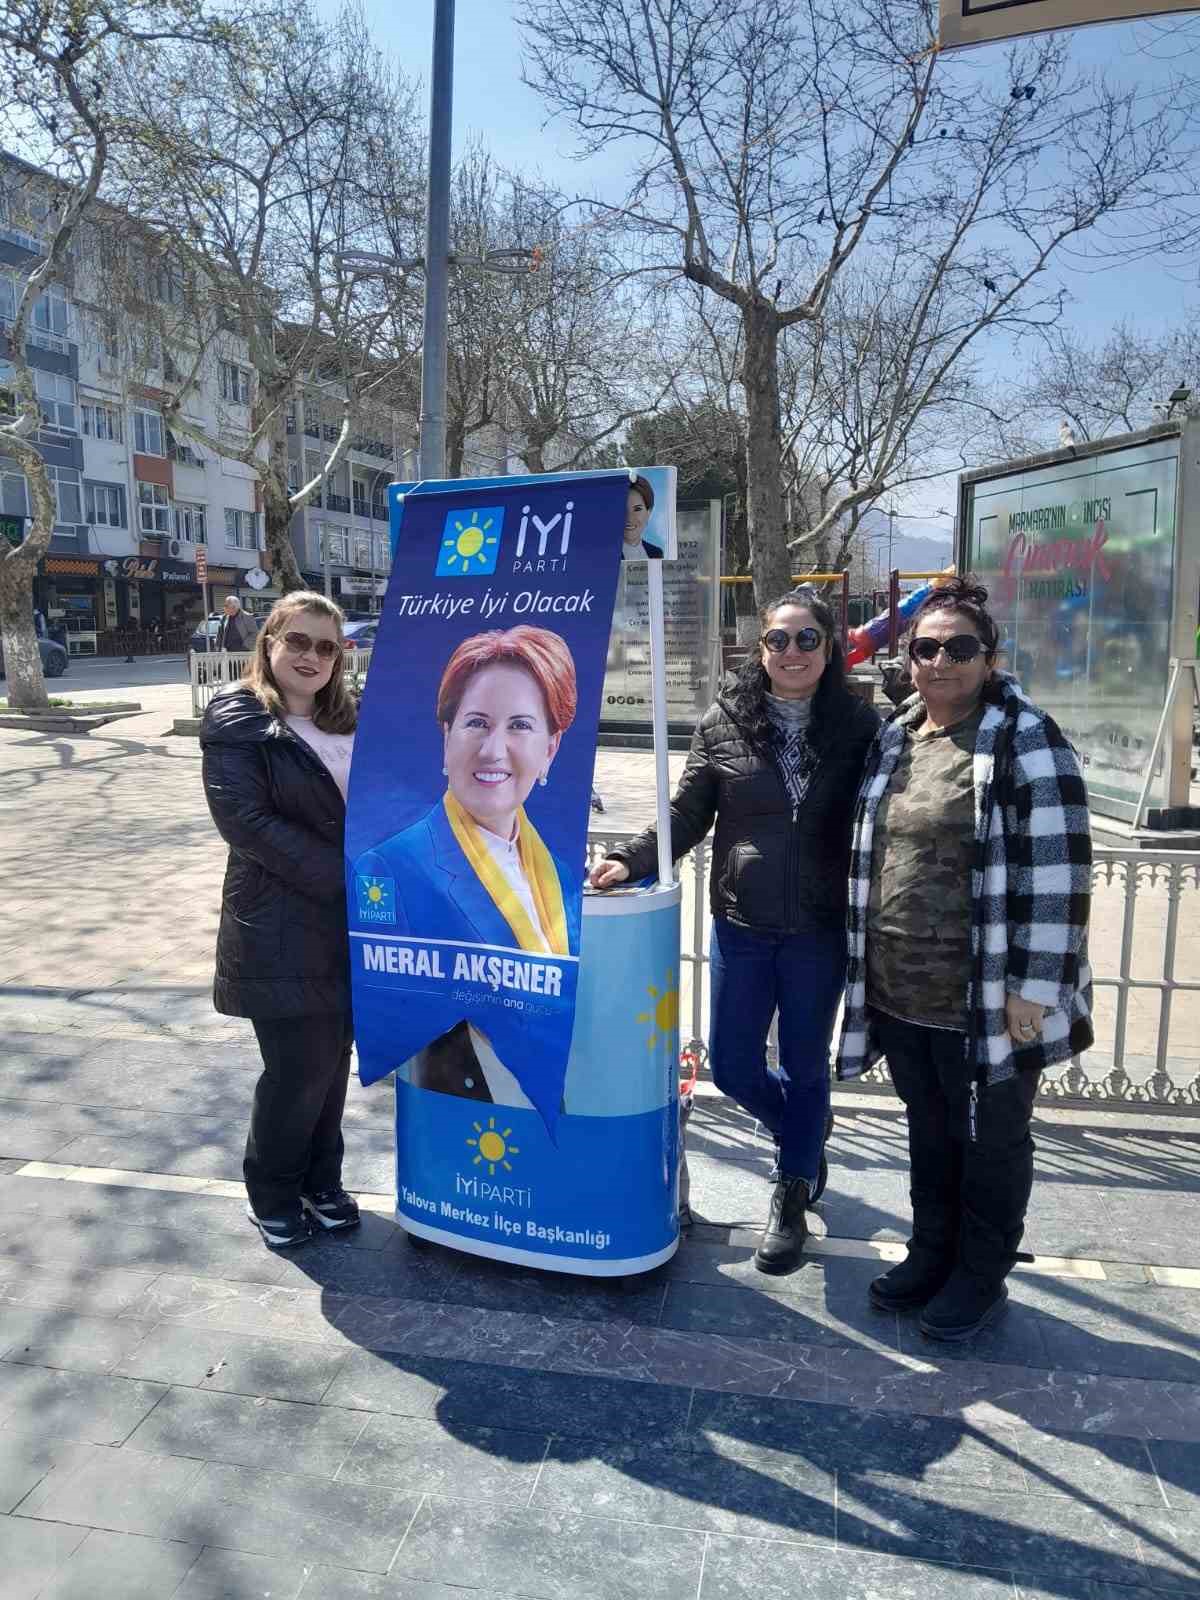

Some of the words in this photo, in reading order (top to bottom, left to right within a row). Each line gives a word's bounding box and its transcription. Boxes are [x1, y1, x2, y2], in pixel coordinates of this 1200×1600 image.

[399, 593, 474, 619] Türkiye
[479, 588, 509, 618] İyi
[512, 589, 594, 614] Olacak
[362, 943, 446, 979] MERAL
[452, 951, 563, 997] AKŞENER
[503, 997, 524, 1010] ana
[401, 1185, 436, 1214] Yalova
[440, 1200, 489, 1228] Merkez
[493, 1211, 521, 1236] İlçe
[526, 1220, 610, 1250] Başkanlığı
